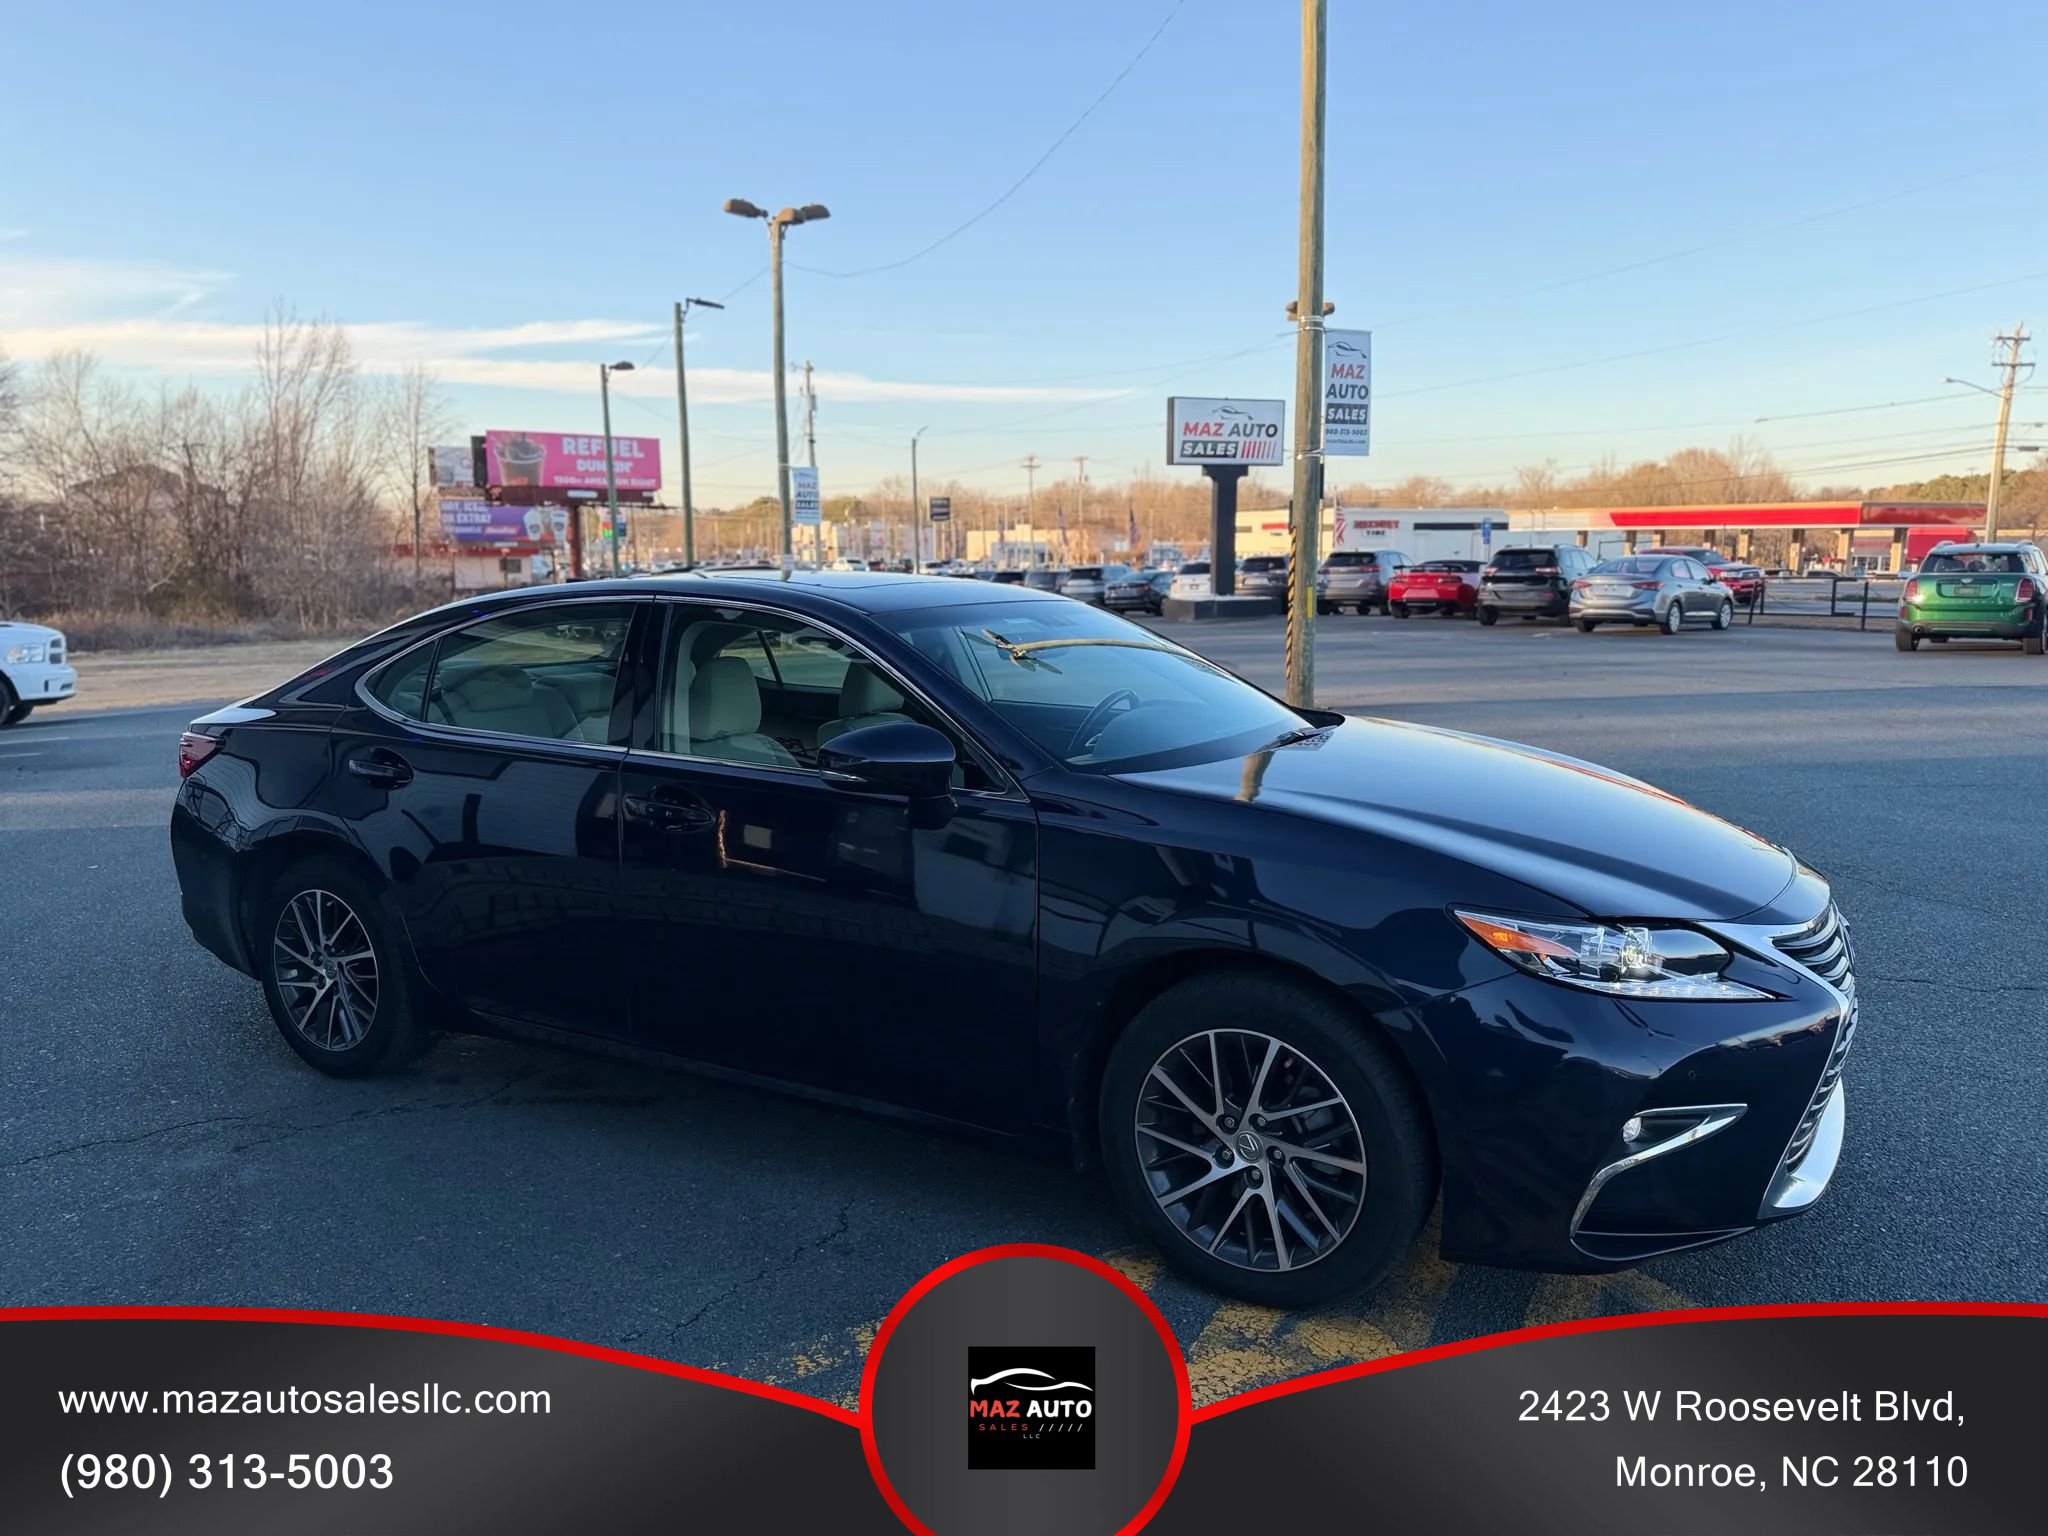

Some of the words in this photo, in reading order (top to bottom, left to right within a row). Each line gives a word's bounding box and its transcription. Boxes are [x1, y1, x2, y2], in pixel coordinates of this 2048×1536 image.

[1331, 363, 1366, 379] MAZ
[1326, 383, 1369, 400] AUTO
[1327, 408, 1367, 421] SALES
[1183, 422, 1225, 437] MAZ
[1228, 423, 1279, 438] AUTO
[1183, 442, 1237, 456] SALES
